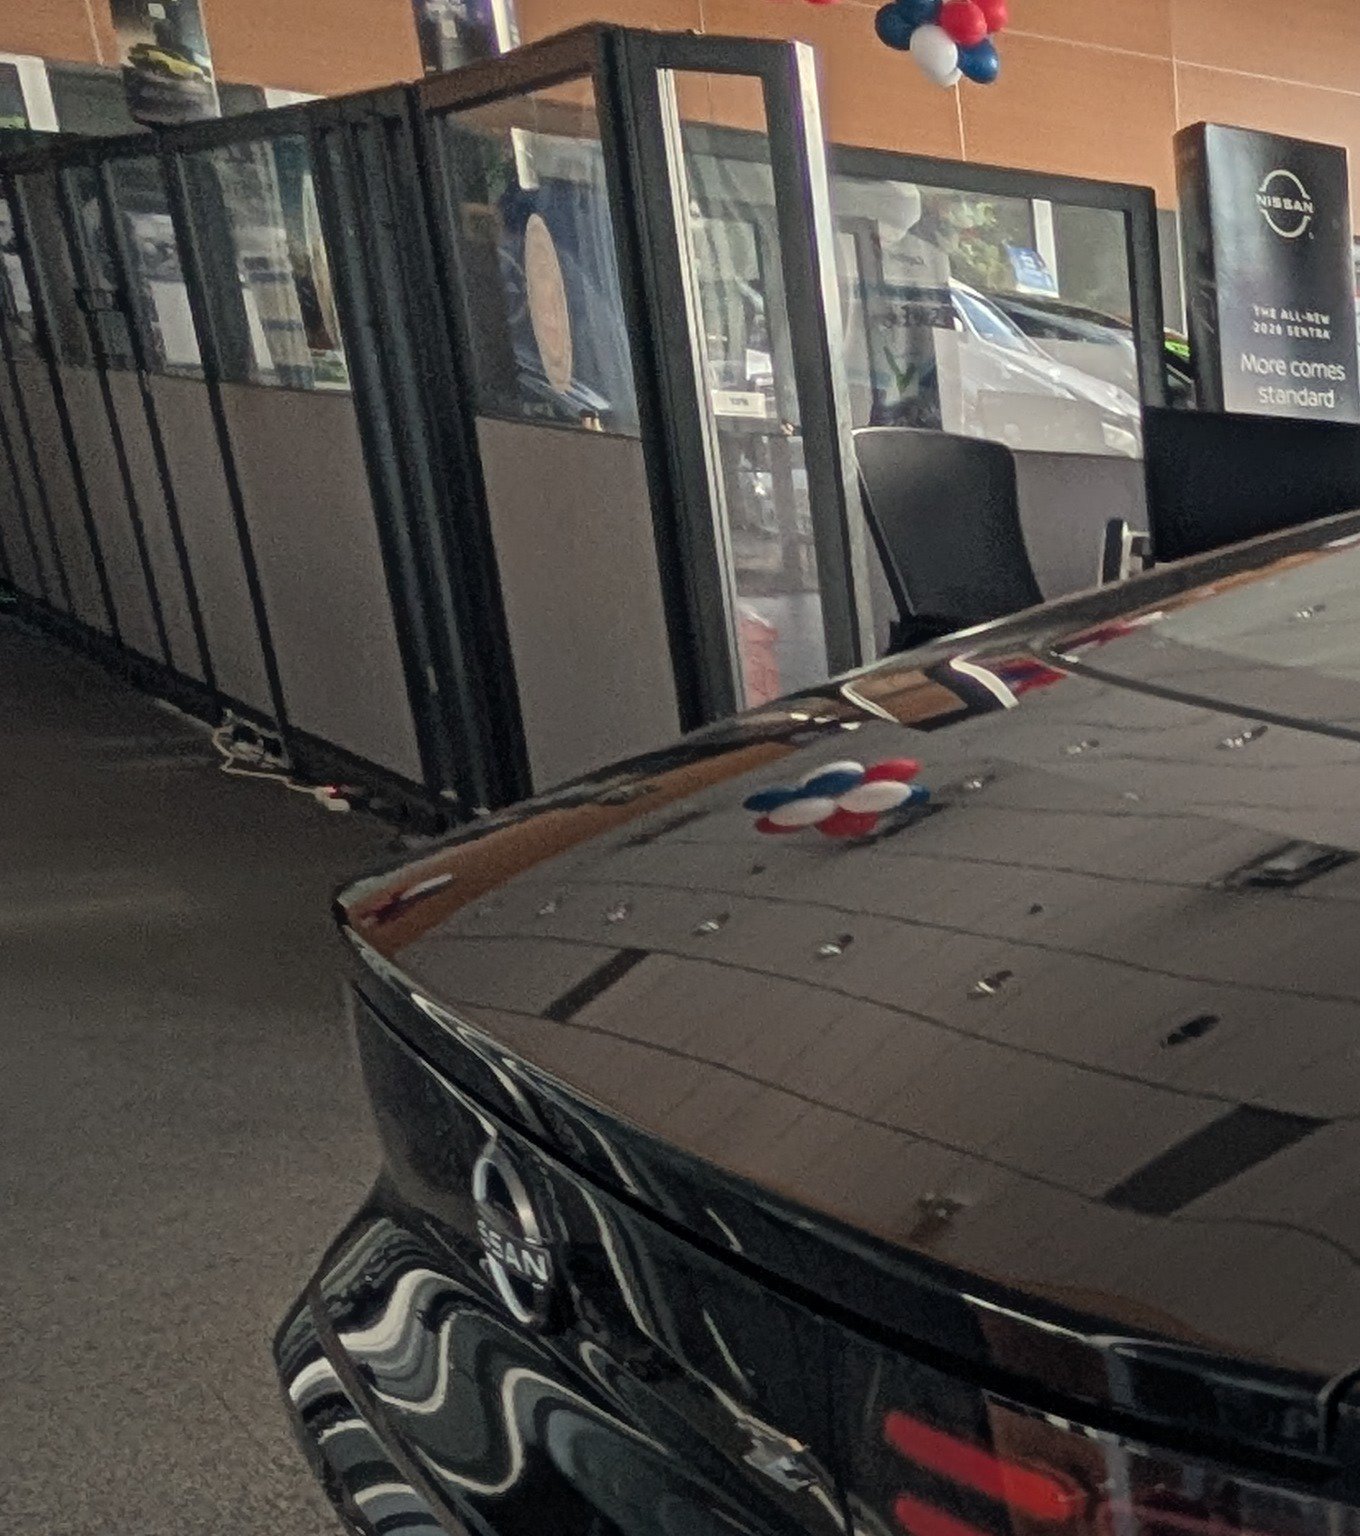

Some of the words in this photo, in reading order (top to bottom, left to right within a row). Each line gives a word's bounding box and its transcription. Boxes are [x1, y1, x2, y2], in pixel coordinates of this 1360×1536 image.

[1255, 193, 1314, 213] NISSAN
[1252, 304, 1277, 320] THE
[1280, 308, 1330, 325] ALL-NEW
[1285, 325, 1331, 340] SENTRA
[1241, 353, 1288, 376] More
[1290, 360, 1346, 381] comes
[1258, 385, 1335, 409] standard
